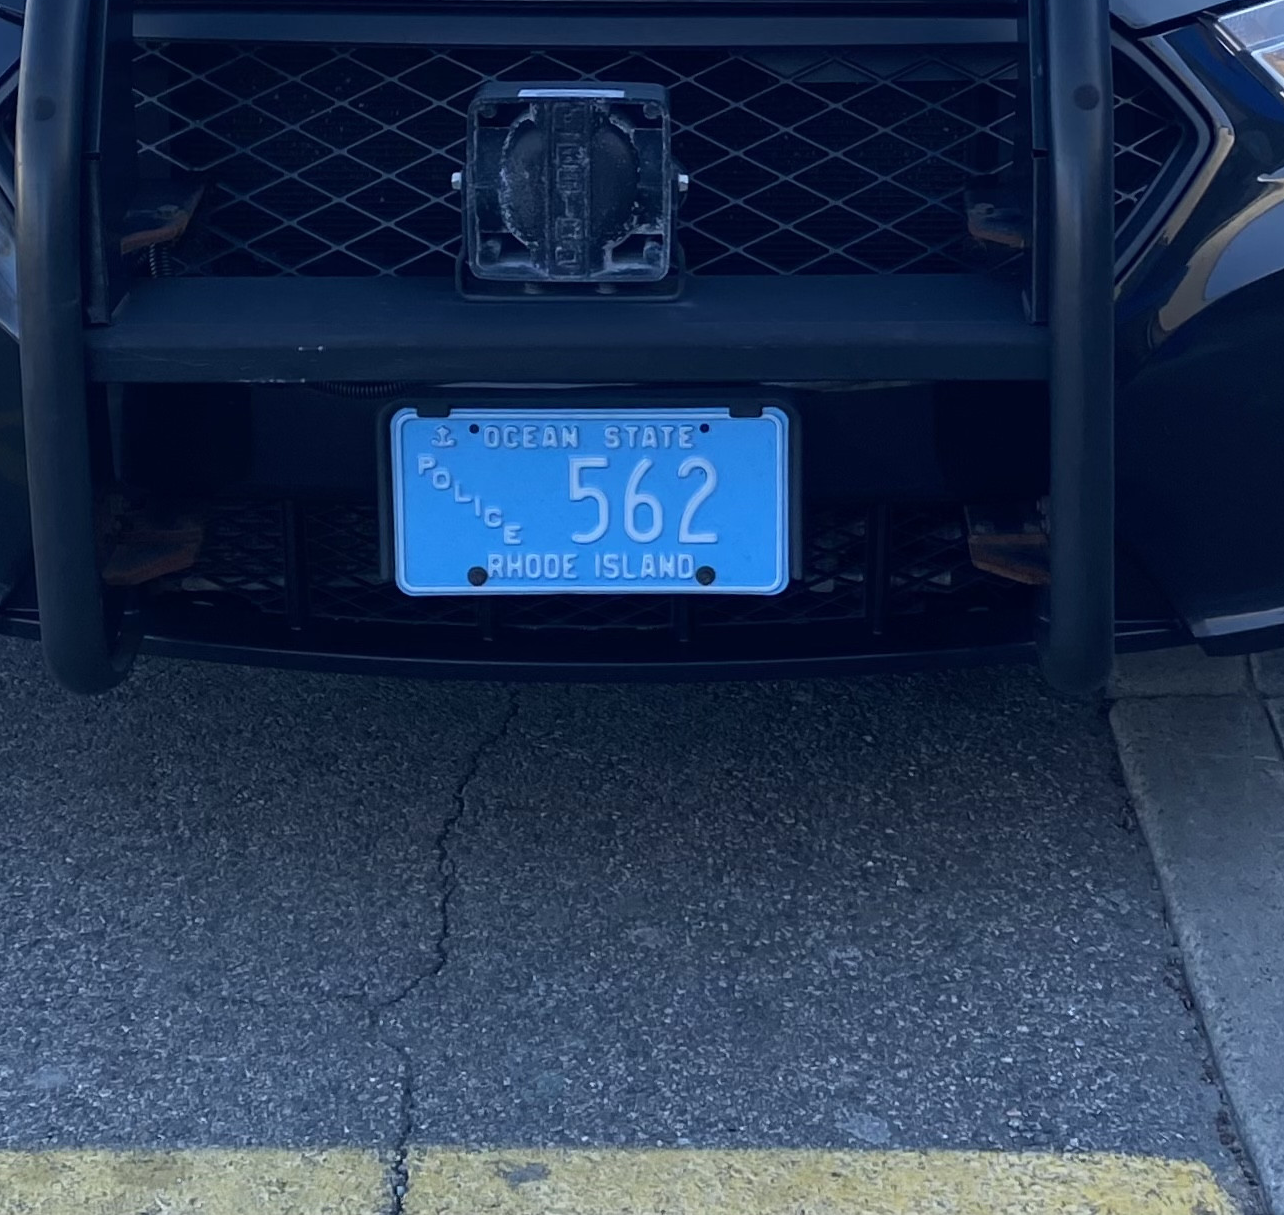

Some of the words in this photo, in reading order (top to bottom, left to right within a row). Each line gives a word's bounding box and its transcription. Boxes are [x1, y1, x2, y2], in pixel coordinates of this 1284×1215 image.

[483, 425, 579, 449] OCEAN
[604, 425, 694, 449] STATE
[417, 454, 522, 545] POLICE
[569, 456, 718, 544] 562
[487, 553, 578, 579] RHODE
[595, 553, 694, 579] ISLAND
